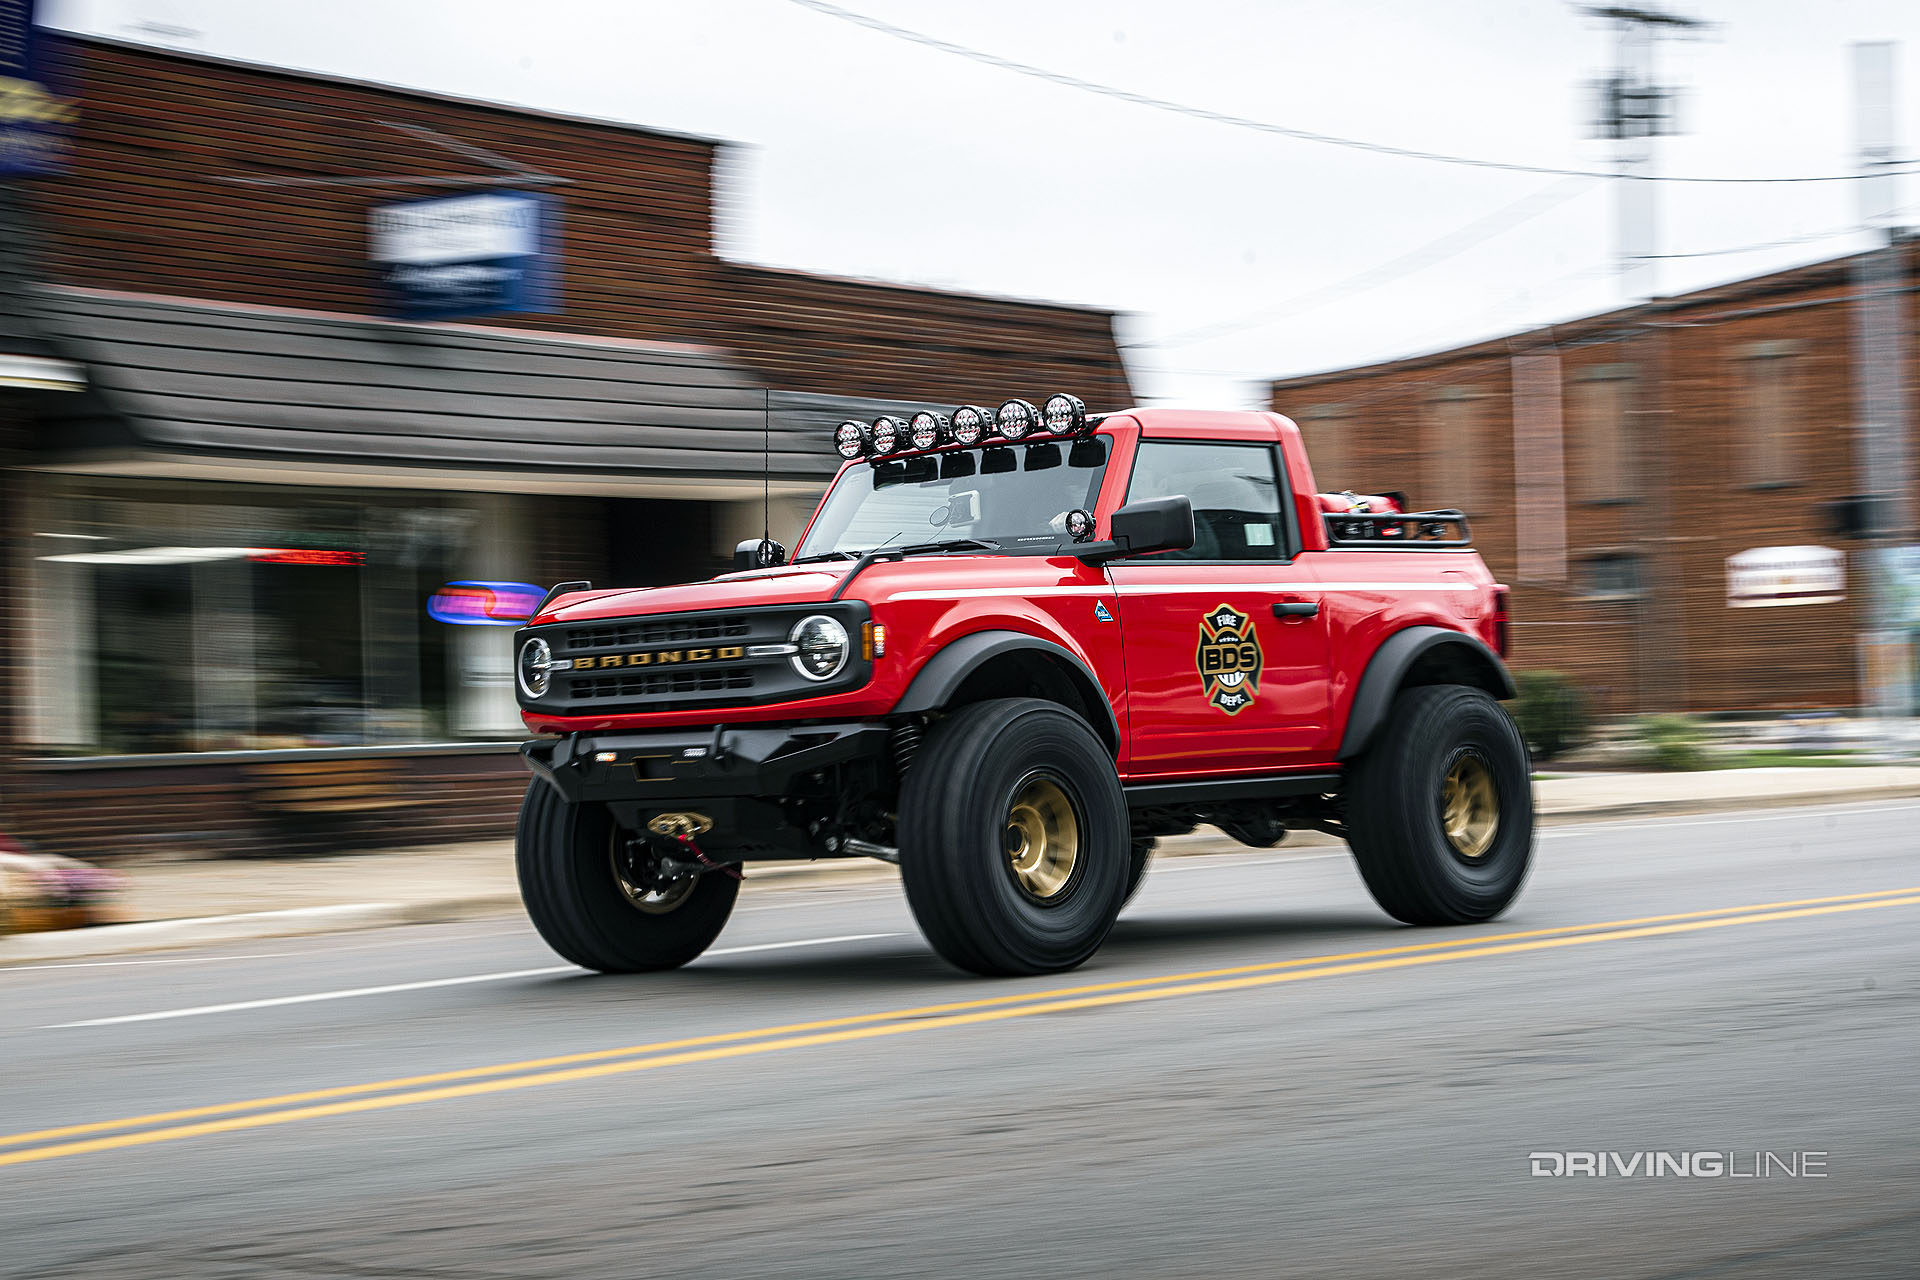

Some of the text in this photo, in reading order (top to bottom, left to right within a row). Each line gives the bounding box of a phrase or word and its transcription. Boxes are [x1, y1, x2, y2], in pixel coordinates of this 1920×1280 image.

[1216, 614, 1237, 626] FIRE
[573, 646, 744, 669] BRONCO
[1203, 642, 1257, 675] BDS
